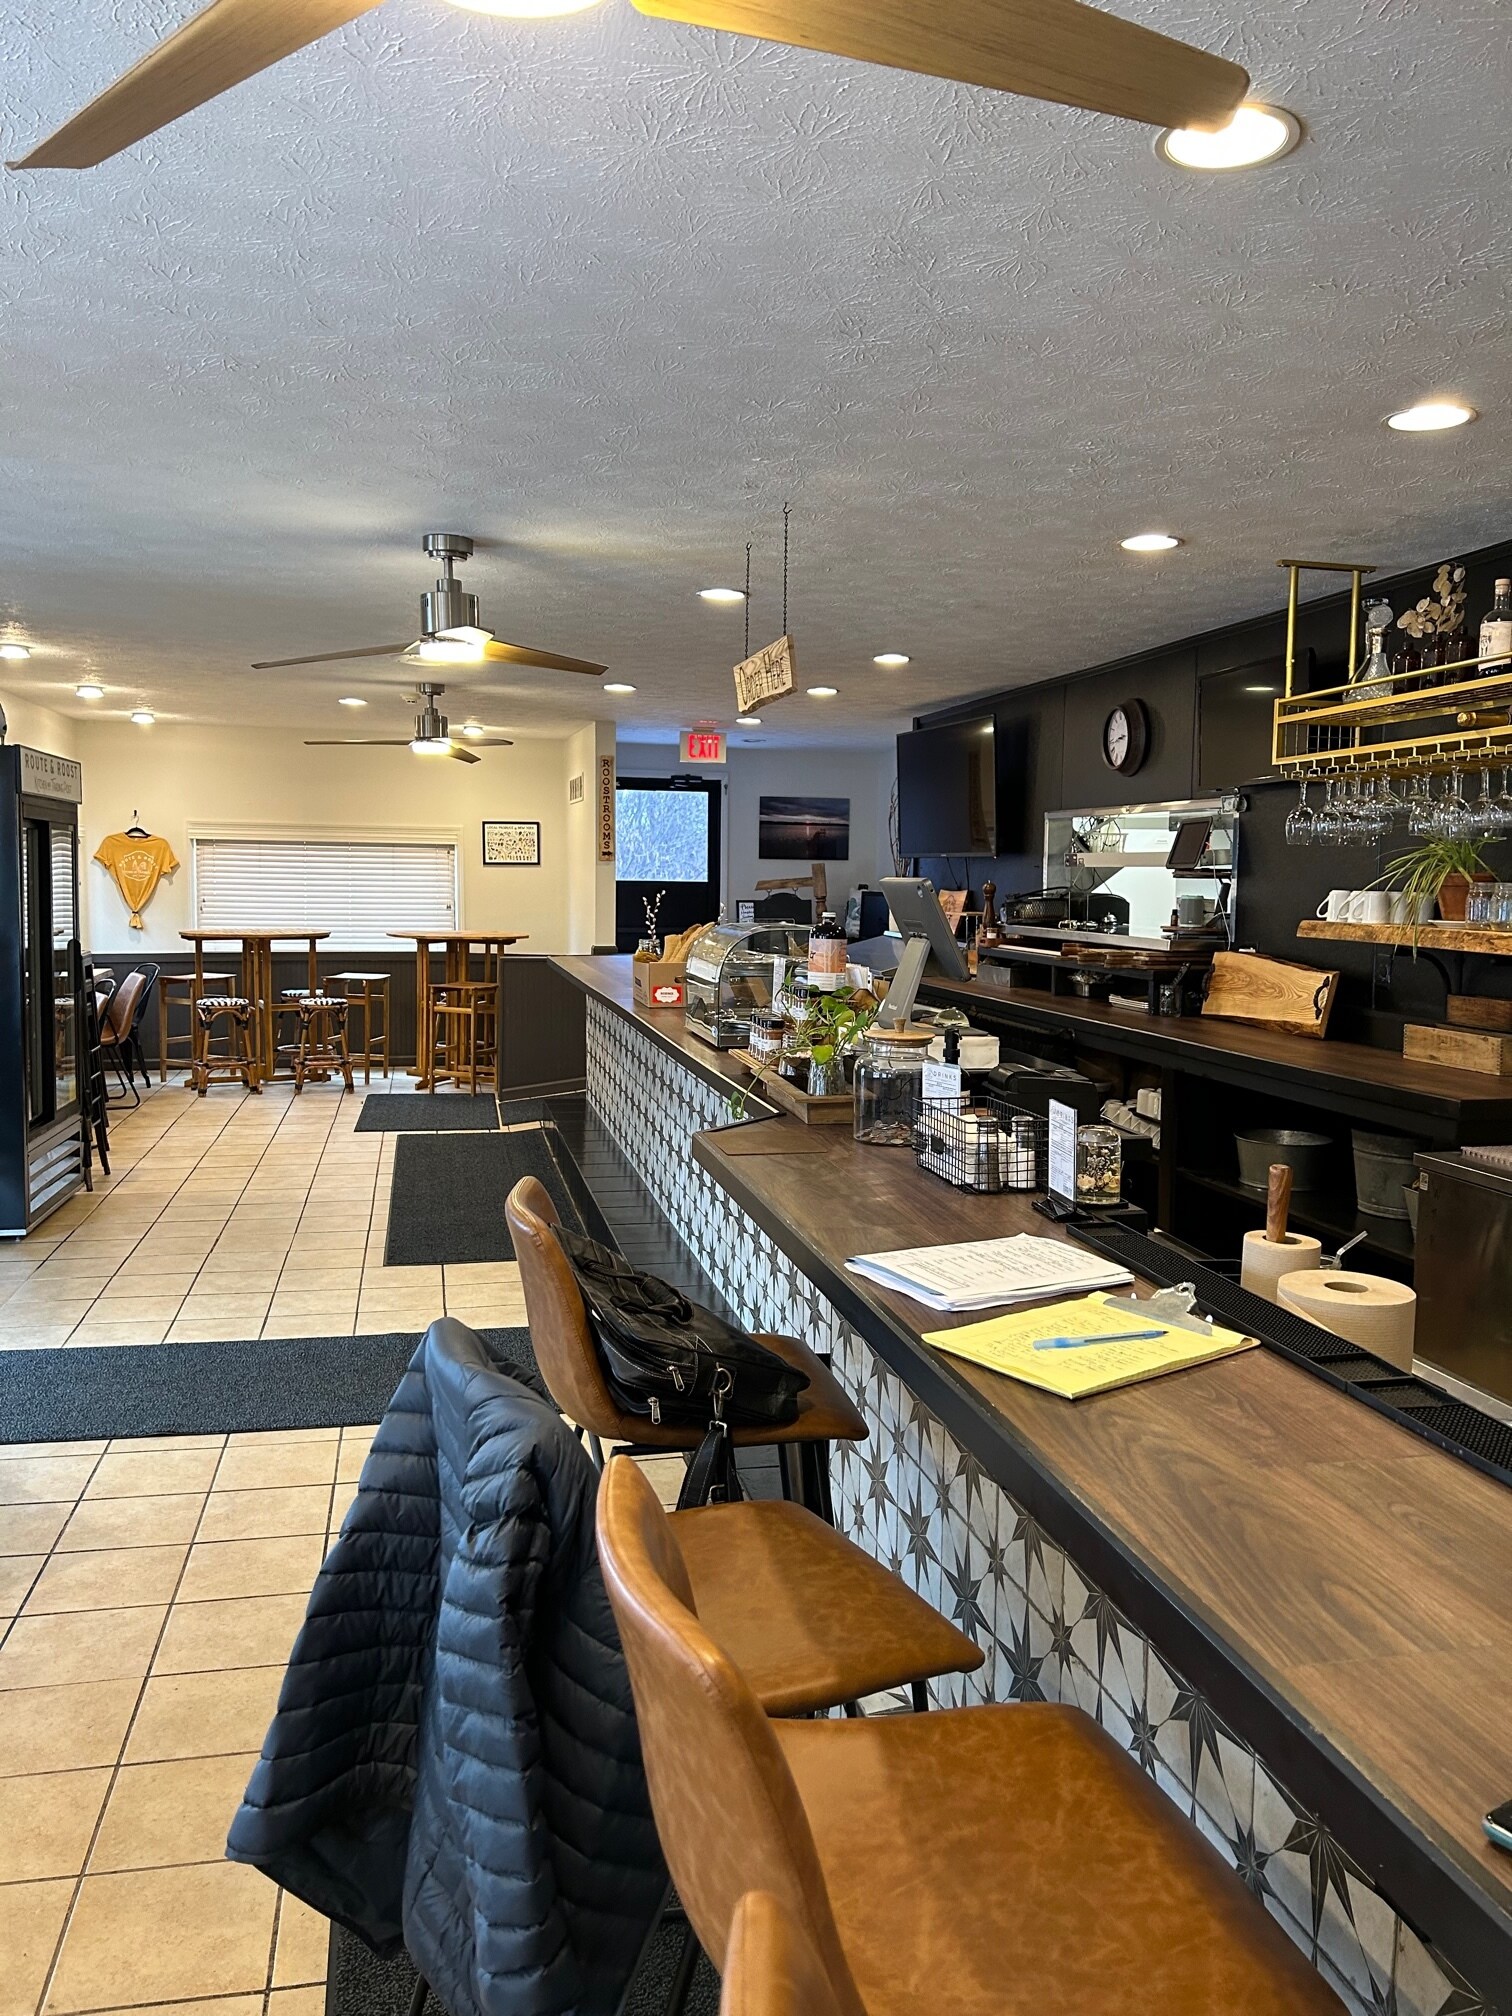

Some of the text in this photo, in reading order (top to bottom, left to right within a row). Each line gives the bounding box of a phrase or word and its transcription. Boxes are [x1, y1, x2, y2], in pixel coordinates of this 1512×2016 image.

[739, 651, 786, 705] ORDER HERE
[688, 734, 720, 759] EXIT
[25, 753, 77, 779] ROUTE & ROOST
[602, 759, 611, 850] ROOSTROOMS
[932, 1070, 957, 1081] DRINKS
